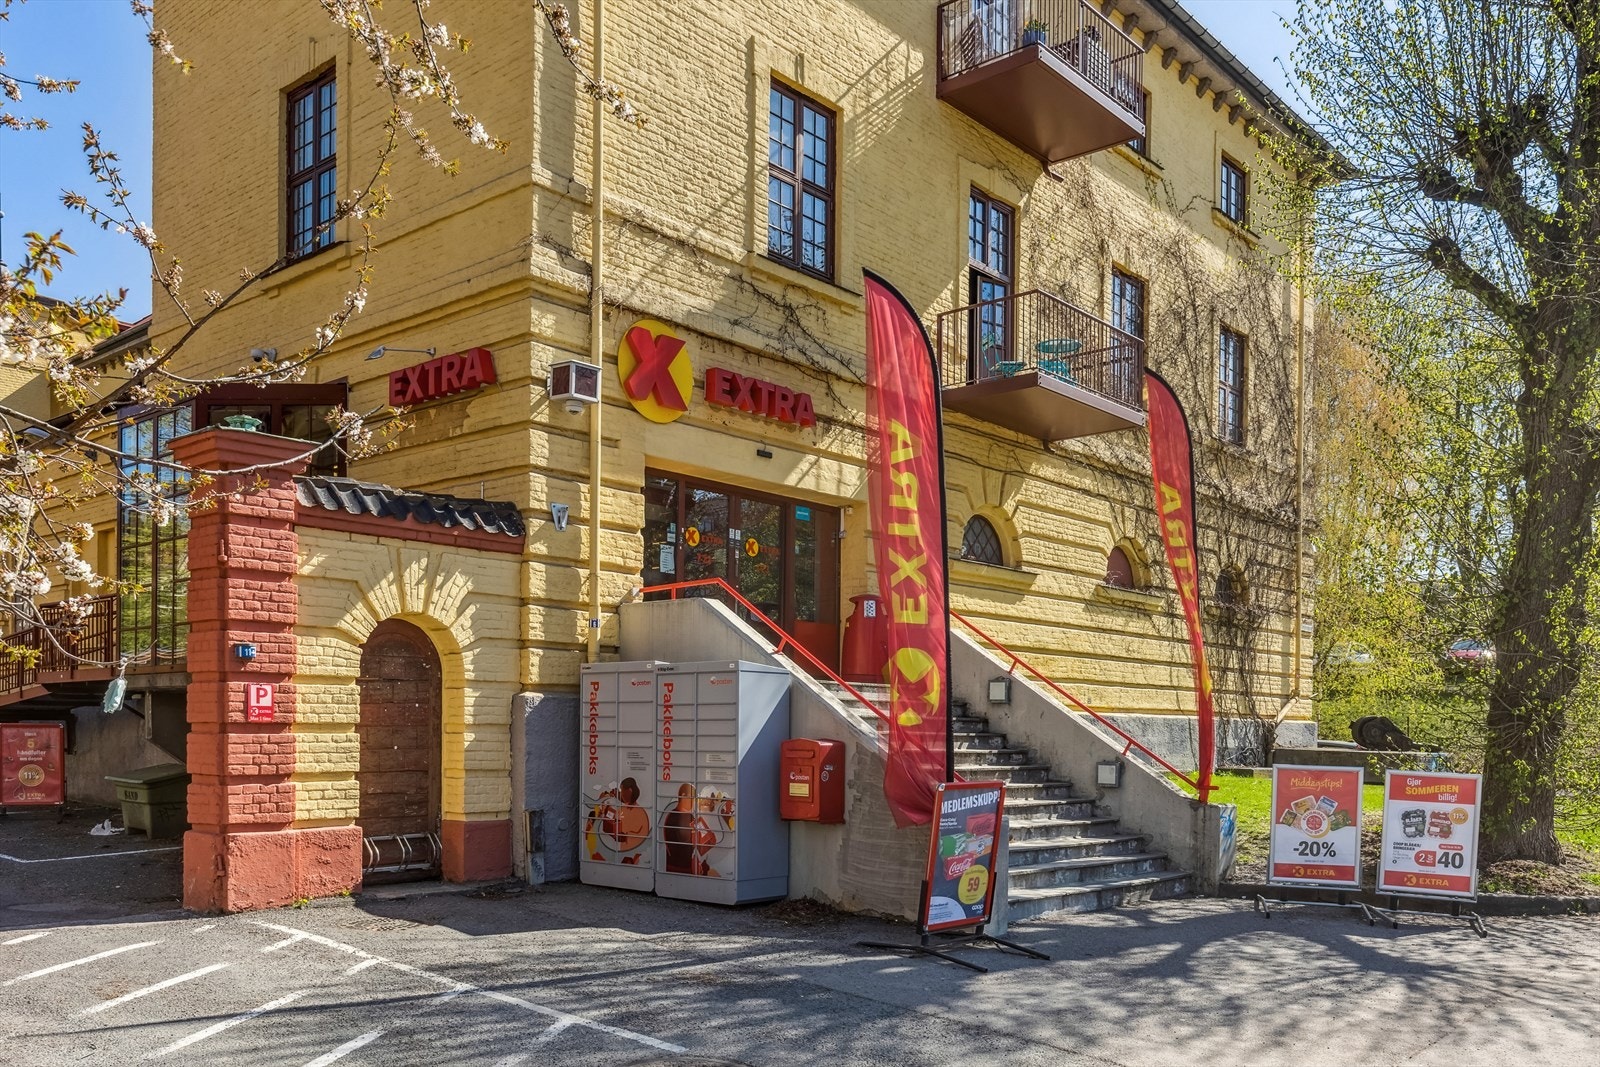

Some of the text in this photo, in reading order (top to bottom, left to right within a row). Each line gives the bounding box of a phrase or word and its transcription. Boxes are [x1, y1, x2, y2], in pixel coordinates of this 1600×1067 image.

[389, 347, 492, 405] EXTRA
[706, 367, 816, 427] EXTRA
[256, 687, 268, 704] P
[589, 681, 600, 775] Pakkeboks
[663, 682, 674, 781] Pakkeboks
[27, 739, 35, 748] 5
[1290, 777, 1343, 791] Middagstips!
[1405, 785, 1459, 795] SOMMEREN
[1407, 778, 1422, 786] Gjør
[941, 791, 1000, 814] MEDLEMSKUPP!
[1438, 793, 1458, 803] billig!
[1293, 841, 1336, 857] -20%
[1419, 853, 1426, 863] 2
[1437, 851, 1464, 869] 40
[1306, 868, 1336, 877] EXTRA
[967, 877, 980, 893] 59
[1420, 877, 1449, 887] EXTRA
